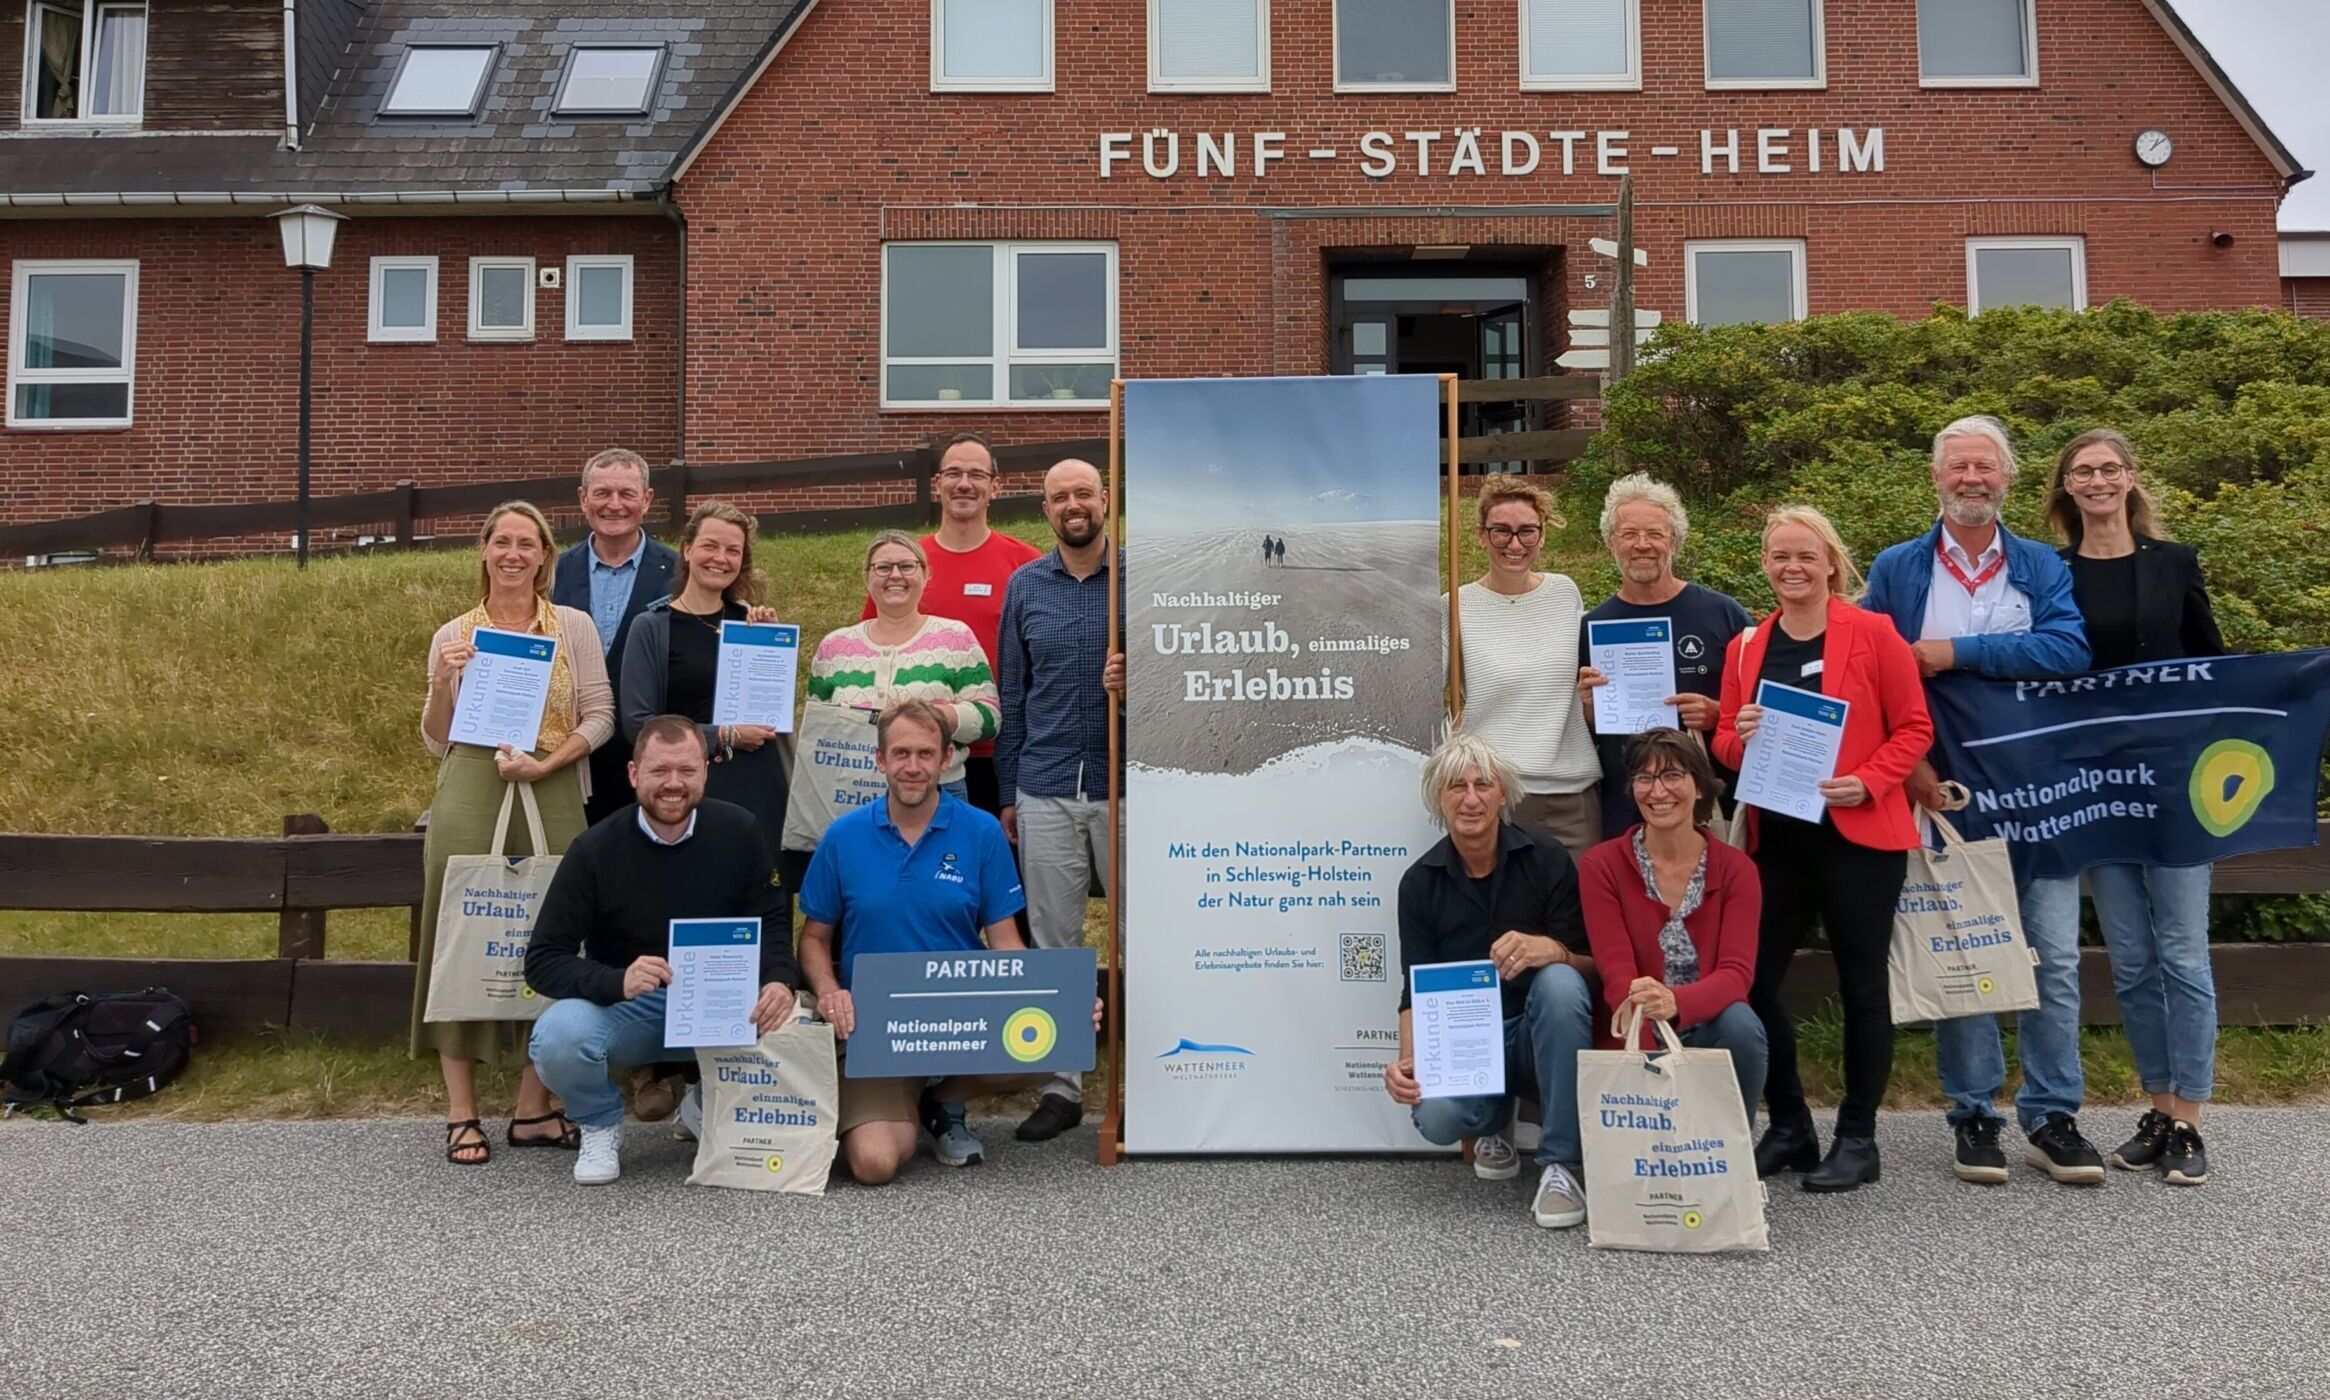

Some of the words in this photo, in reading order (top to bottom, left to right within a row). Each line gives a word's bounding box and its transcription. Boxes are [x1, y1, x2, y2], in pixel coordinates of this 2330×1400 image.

[1584, 275, 1596, 289] 5
[1151, 592, 1282, 610] Nachhaltiger
[1151, 621, 1300, 659] Urlaub,
[1308, 636, 1411, 655] einmaliges
[723, 647, 743, 722] Urkunde
[1183, 668, 1355, 702] Erlebnis
[461, 656, 494, 734] Urkunde
[816, 738, 876, 754] Nachhaltig
[1746, 713, 1780, 795] Urkunde
[814, 750, 878, 773] Urlaub,
[852, 778, 887, 789] einma
[1976, 762, 2156, 813] Nationalpark
[834, 789, 878, 806] Erle
[1993, 800, 2158, 844] Wattenmeer
[1168, 843, 1197, 859] Mit
[1202, 843, 1230, 858] den
[1235, 841, 1408, 861] Nationalpark-Partnern
[939, 873, 964, 883] NABU
[1206, 867, 1221, 883] in
[1226, 866, 1372, 887] Schleswig-Holstein
[464, 887, 538, 902] Nachhaltiger
[1198, 892, 1223, 908] der
[1229, 892, 1275, 908] Natur
[1279, 894, 1313, 912] ganz
[1318, 892, 1346, 907] nah
[1351, 891, 1381, 907] sein
[462, 901, 531, 920] Urlaub,
[485, 941, 528, 958] Erle
[1930, 928, 2012, 953] Erlebnis
[1195, 949, 1211, 957] Alle
[1213, 948, 1263, 959] nachhaltigen
[1300, 947, 1316, 955] und
[924, 958, 1025, 978] PARTNER
[1264, 960, 1290, 968] finden
[1292, 960, 1304, 968] Sie
[1306, 959, 1325, 968] hier:
[676, 951, 696, 1037] Urkunde
[886, 1018, 988, 1035] Nationalpark
[1356, 1030, 1399, 1040] PARTNE
[891, 1037, 987, 1052] Wattenmeer
[1422, 996, 1442, 1087] Urkunde
[1164, 1061, 1246, 1073] WATTENMEER
[1345, 1061, 1388, 1070] Nationalpa
[1348, 1071, 1385, 1079] Wattenm
[717, 1067, 778, 1087] Urlaub,
[752, 1093, 817, 1107] einmaliges
[734, 1107, 817, 1127] Erlebnis
[1600, 1109, 1677, 1134] Urlaub,
[742, 1137, 772, 1145] PARTNER
[1651, 1138, 1725, 1153] einmaliges
[1633, 1156, 1728, 1178] Erlebnis
